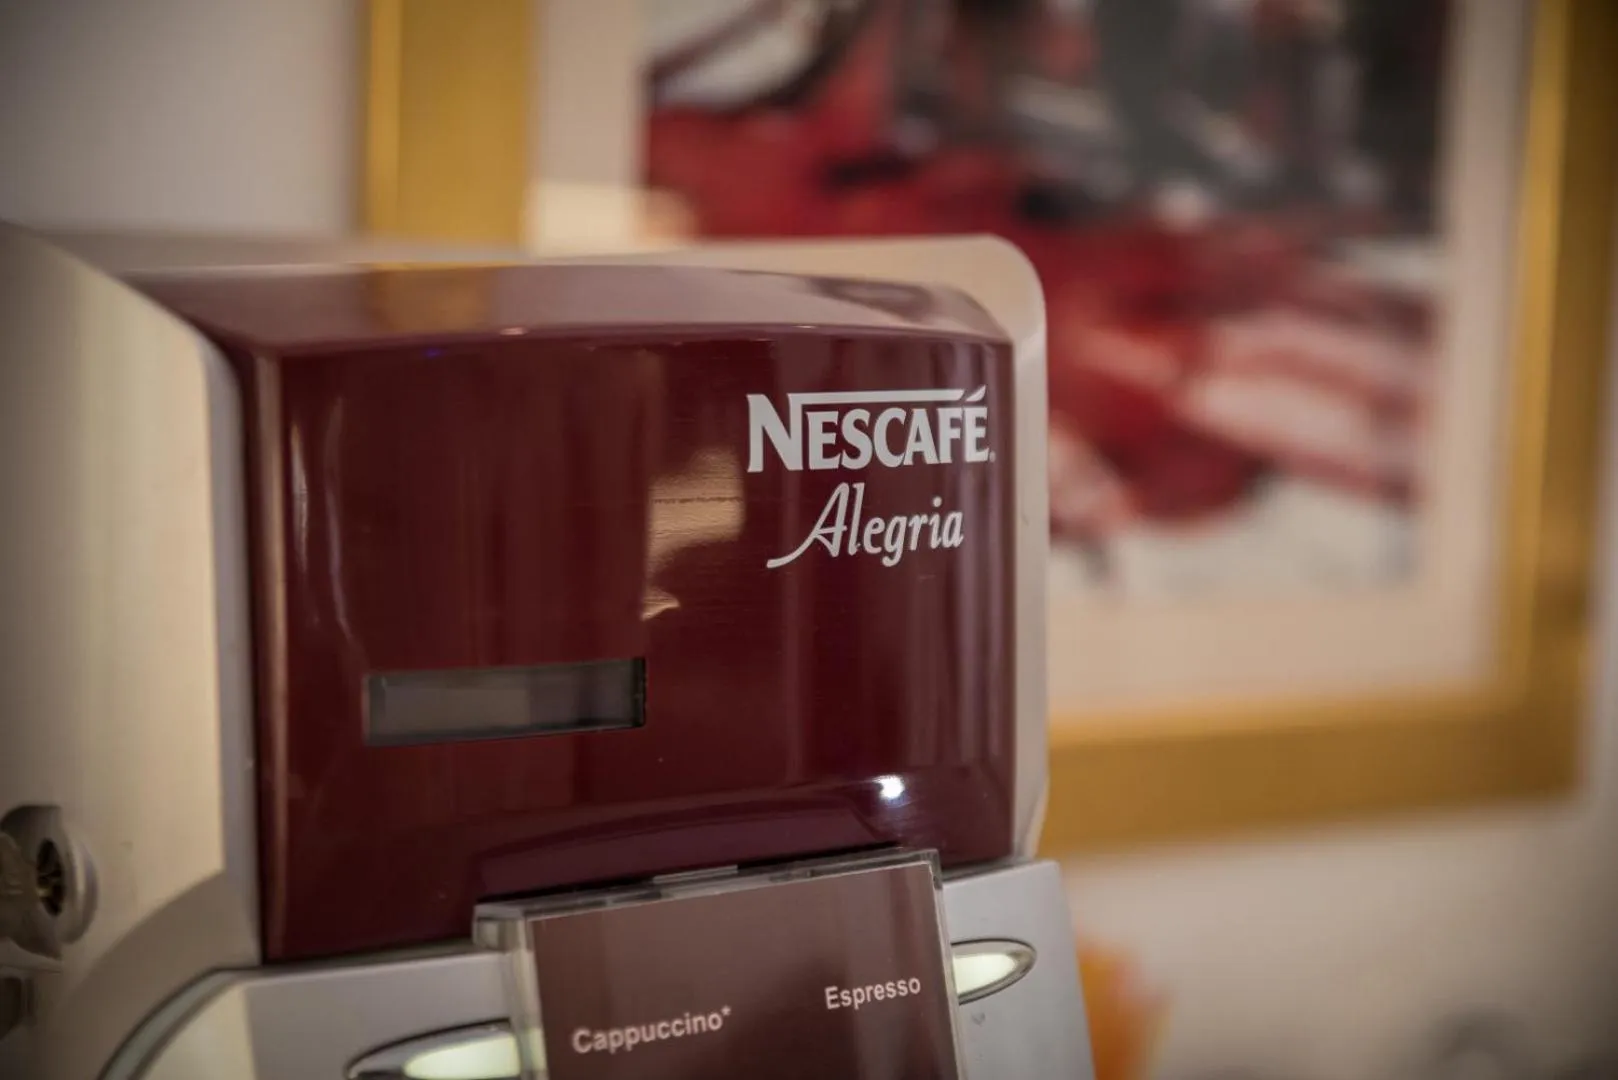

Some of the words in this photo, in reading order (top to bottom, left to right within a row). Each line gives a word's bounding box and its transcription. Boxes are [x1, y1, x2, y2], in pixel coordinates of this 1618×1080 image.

[746, 384, 990, 472] NESCAFÉ
[767, 482, 964, 568] Alegria
[825, 976, 921, 1010] Espresso
